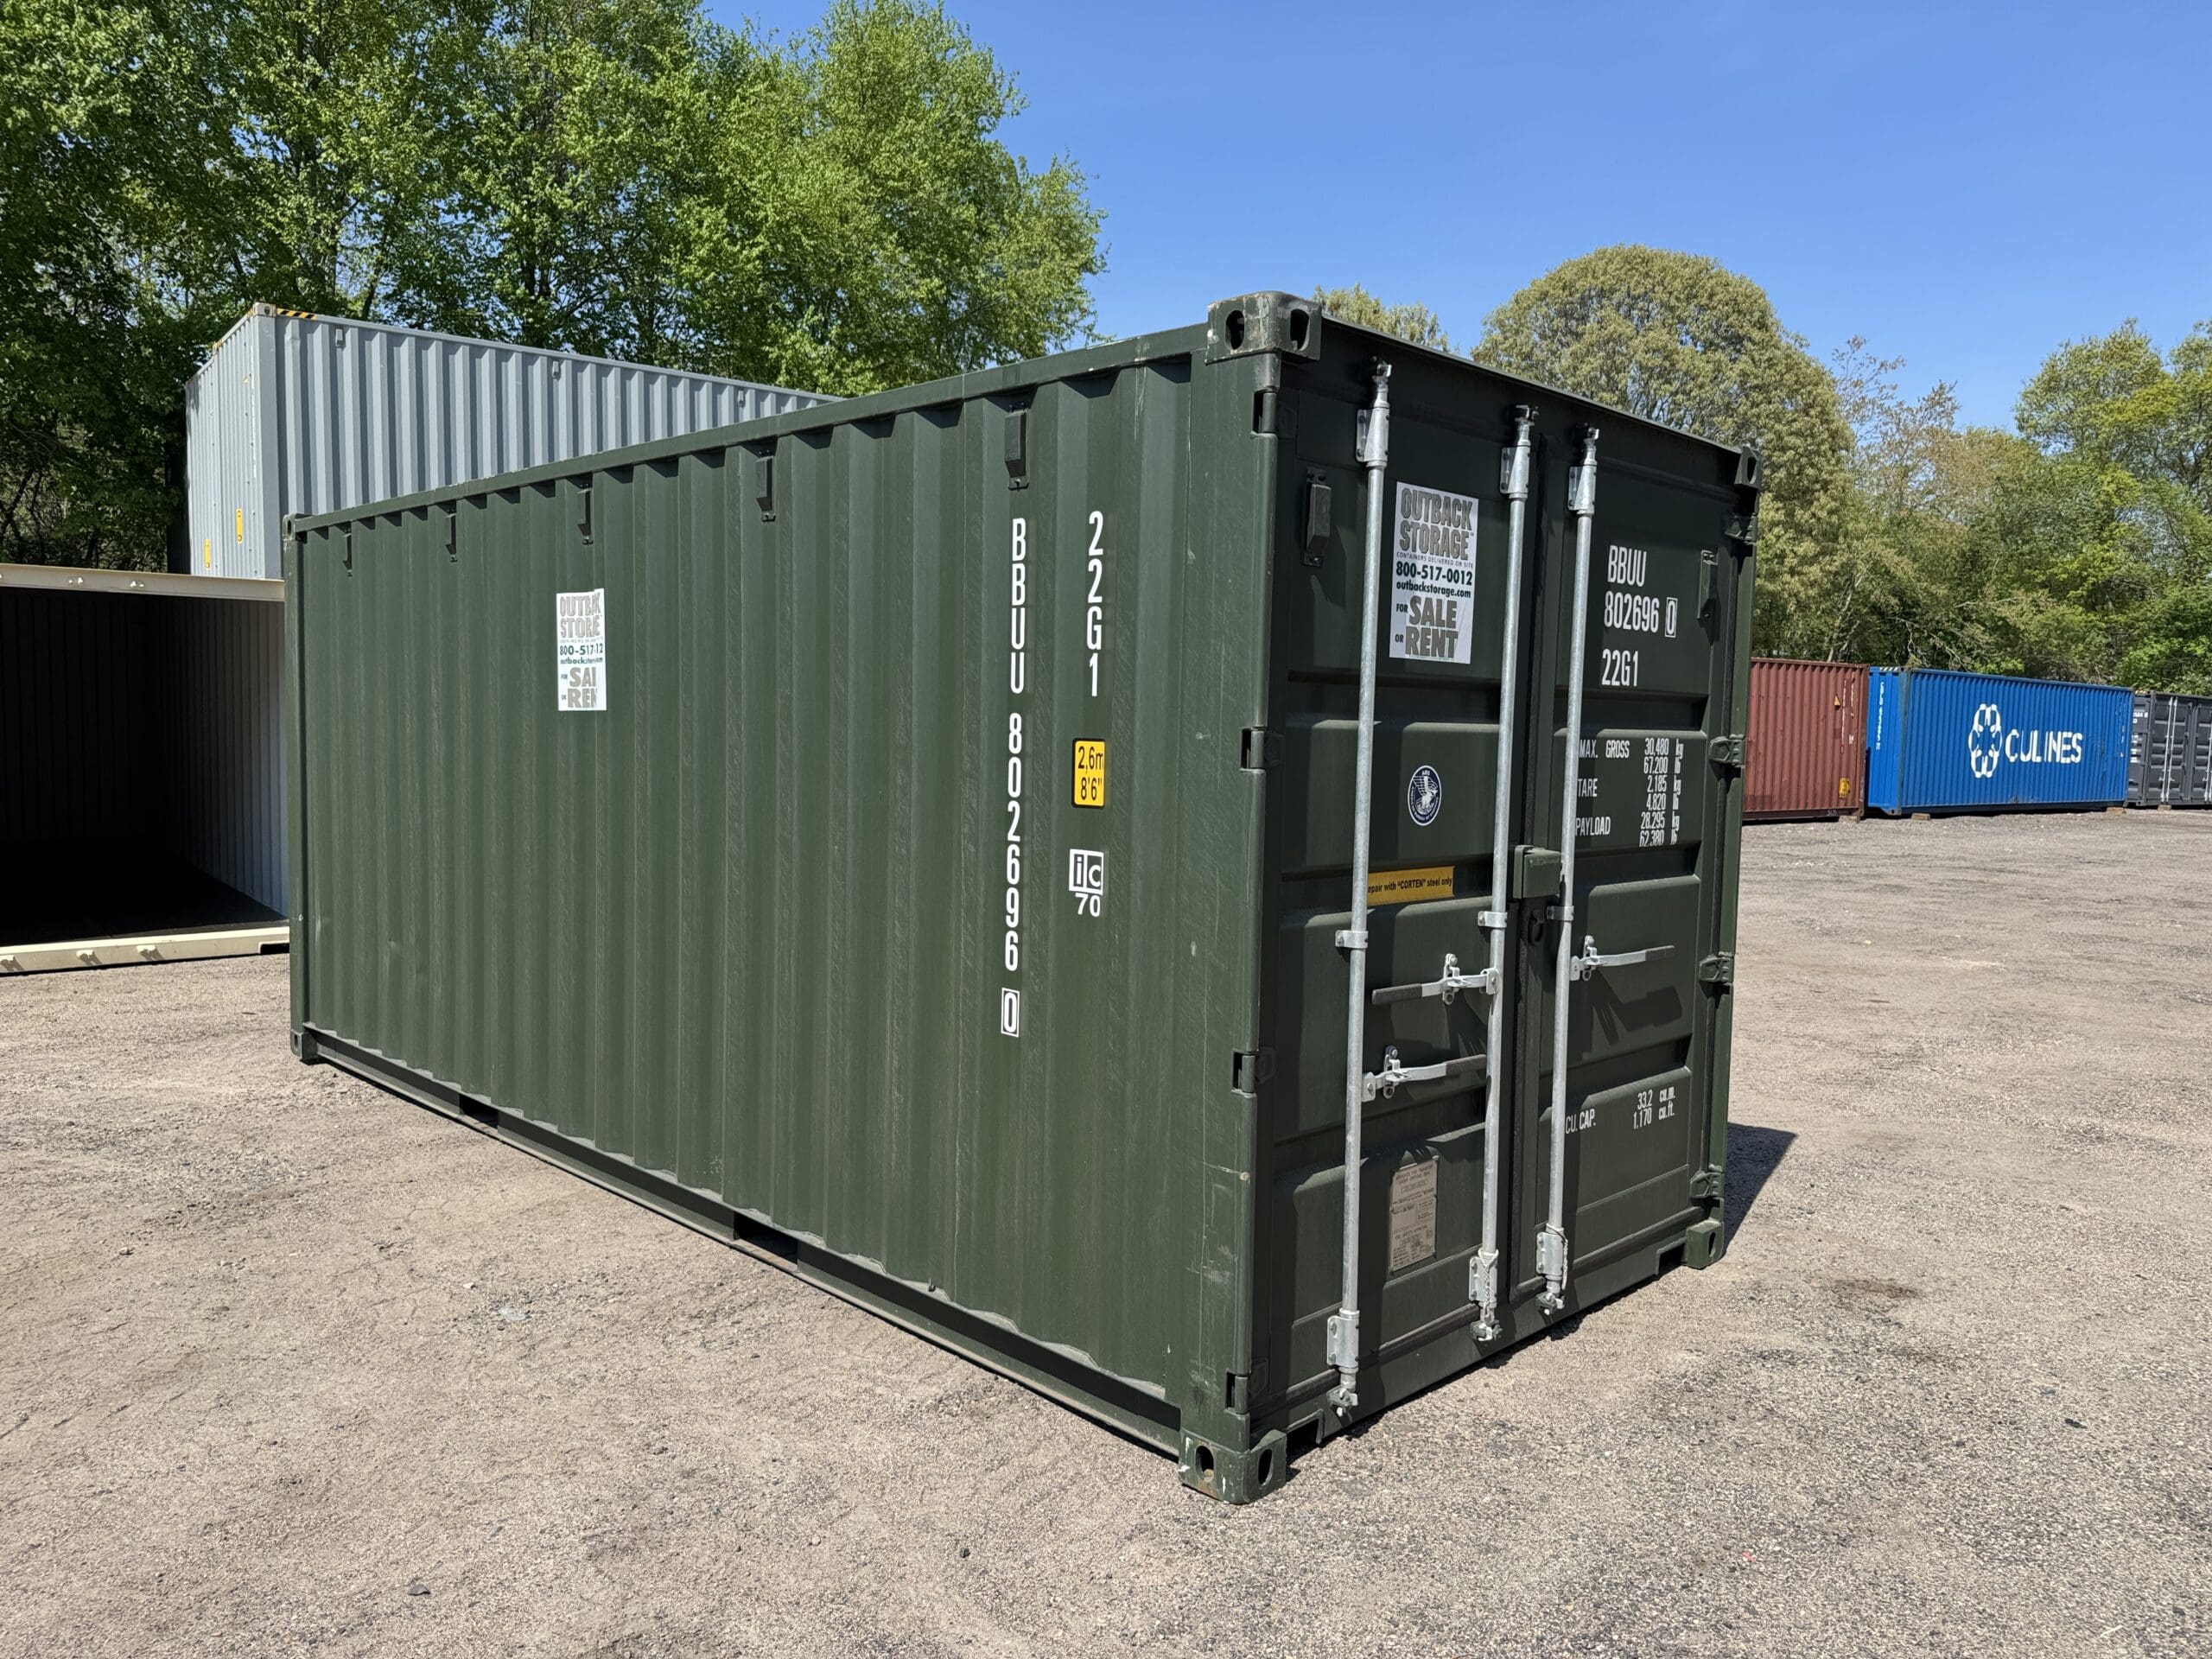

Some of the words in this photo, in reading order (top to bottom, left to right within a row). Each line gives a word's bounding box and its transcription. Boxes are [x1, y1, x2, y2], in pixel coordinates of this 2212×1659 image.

[1400, 487, 1473, 531] OUTBACK
[1399, 519, 1470, 561] STORAGE
[1396, 551, 1427, 562] CONTAINERS
[1427, 556, 1454, 567] DELIVERED
[1607, 544, 1647, 587] BBUU
[1395, 561, 1473, 586] 800-517-0012
[1396, 579, 1471, 598] outbackstorage.com
[1010, 518, 1026, 694] BBUU
[1086, 511, 1103, 696] 22G1
[1395, 603, 1408, 613] FOR
[1408, 595, 1458, 629] SALE
[1604, 590, 1660, 633] 802696
[1666, 599, 1676, 636] 0
[1395, 634, 1404, 643] OR
[1405, 626, 1459, 658] RENT
[1601, 648, 1639, 687] 22G1
[1579, 739, 1599, 759] MAX.
[1605, 740, 1630, 759] GROSS
[1675, 738, 1684, 760] kg
[2005, 728, 2083, 764] CULINES
[1675, 756, 1681, 774] lb
[1577, 778, 1598, 798] TARE
[1673, 774, 1681, 796] kg
[1672, 792, 1679, 810] lb
[1575, 817, 1611, 836] PAYLOAD
[1671, 810, 1680, 831] kg
[1005, 712, 1022, 971] 802696
[1669, 829, 1678, 845] lb
[1368, 885, 1382, 895] epair
[1384, 880, 1396, 891] with
[1427, 876, 1440, 887] steel
[1441, 875, 1452, 887] only
[1074, 893, 1102, 918] 70
[1565, 1116, 1578, 1135] CU.
[1579, 1109, 1597, 1130] CAP.
